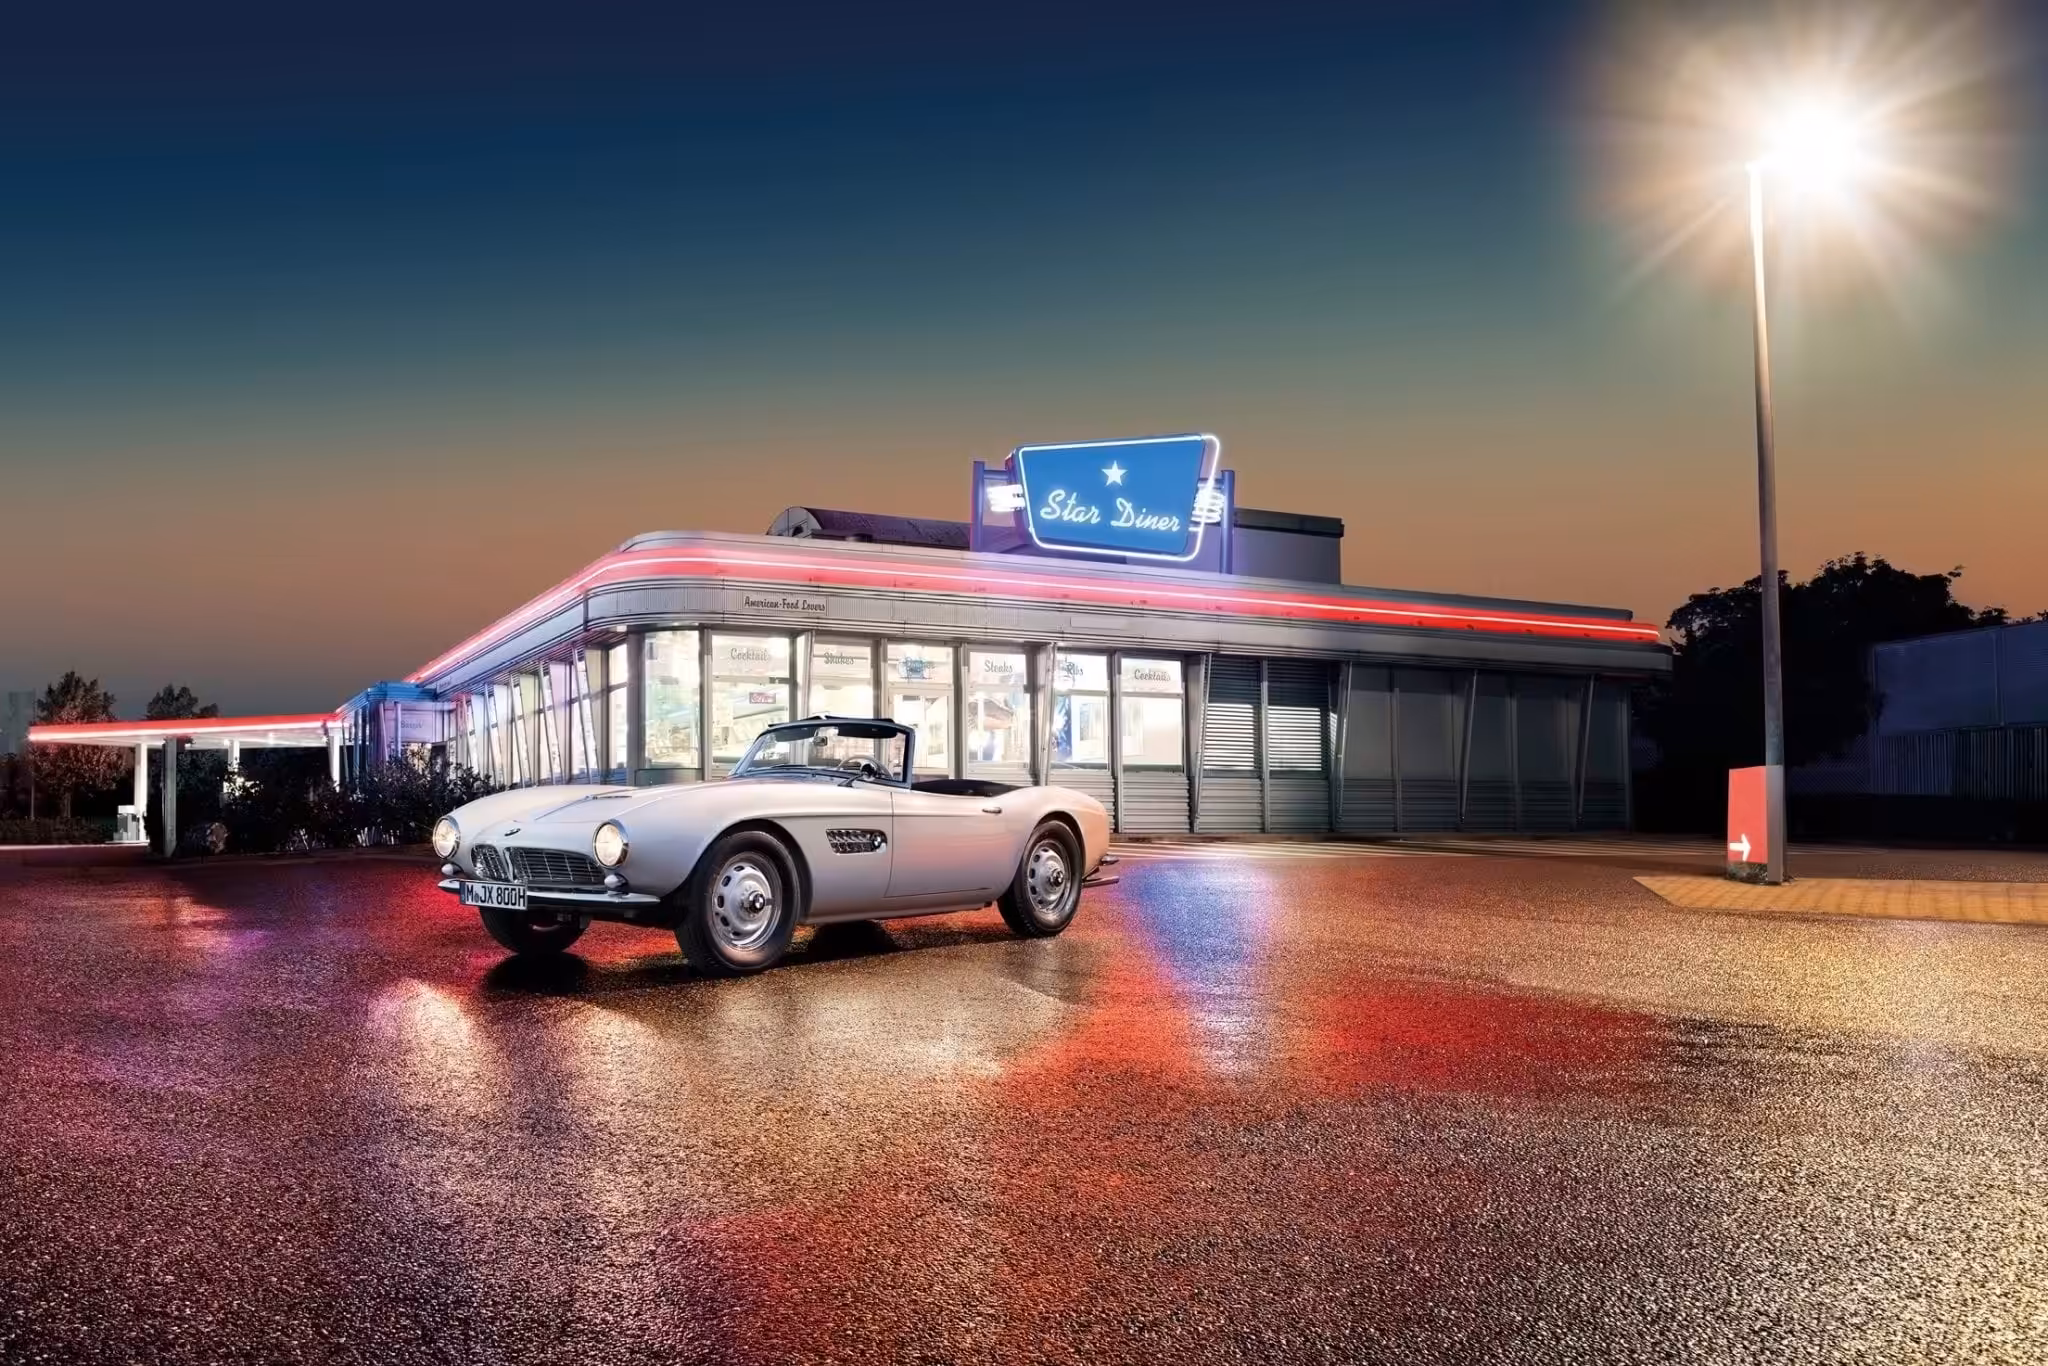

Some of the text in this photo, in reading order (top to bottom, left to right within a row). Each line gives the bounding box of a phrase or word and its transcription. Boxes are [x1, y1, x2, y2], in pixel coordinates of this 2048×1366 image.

[1040, 489, 1181, 532] Star Diner
[801, 599, 826, 612] Lovers
